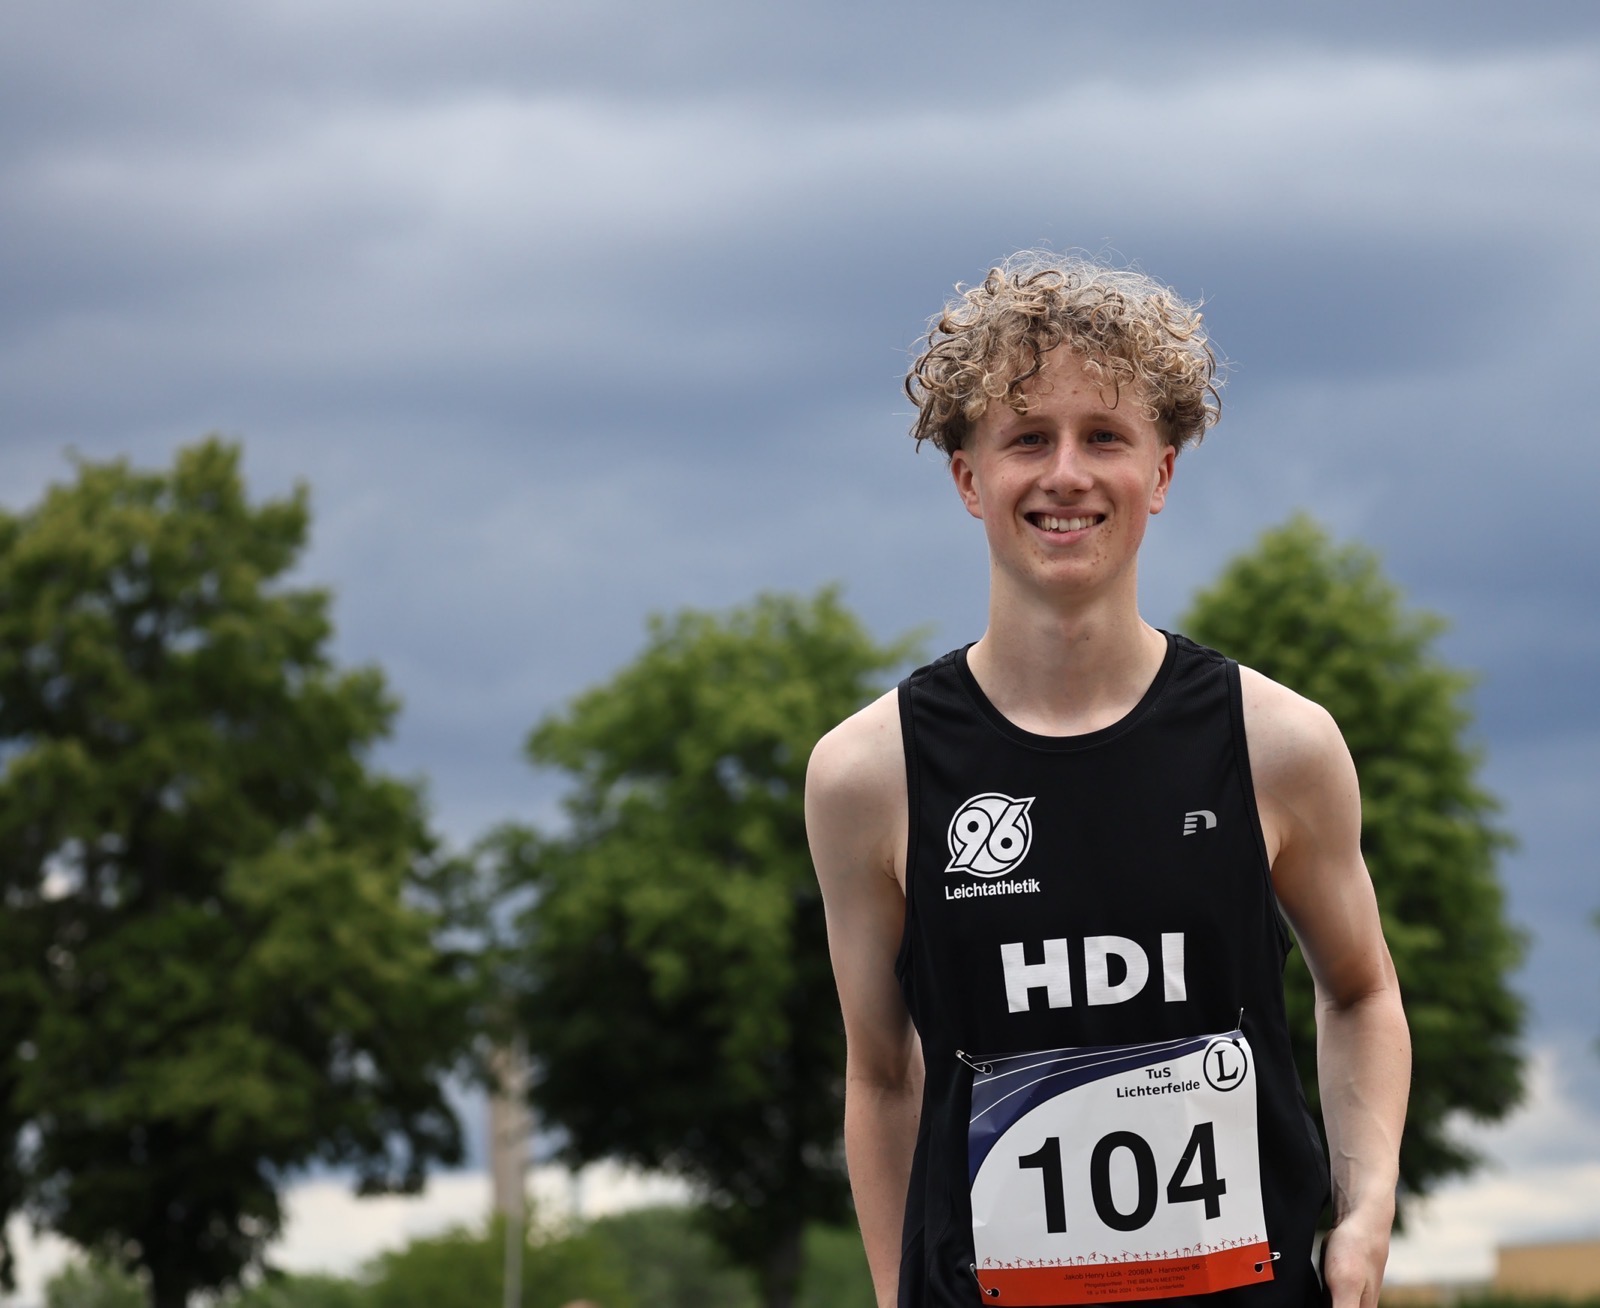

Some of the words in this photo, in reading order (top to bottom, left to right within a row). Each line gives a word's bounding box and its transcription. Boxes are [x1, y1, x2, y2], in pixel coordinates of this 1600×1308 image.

[955, 807, 1025, 863] 96
[945, 879, 1041, 900] Leichtathletik
[1000, 932, 1187, 1013] HDI
[1146, 1067, 1172, 1079] TuS
[1214, 1050, 1239, 1082] L
[1116, 1081, 1201, 1099] Lichterfelde
[1018, 1121, 1227, 1234] 104
[1085, 1272, 1104, 1280] Henry
[1158, 1265, 1190, 1273] Hannover
[1191, 1263, 1201, 1271] 96
